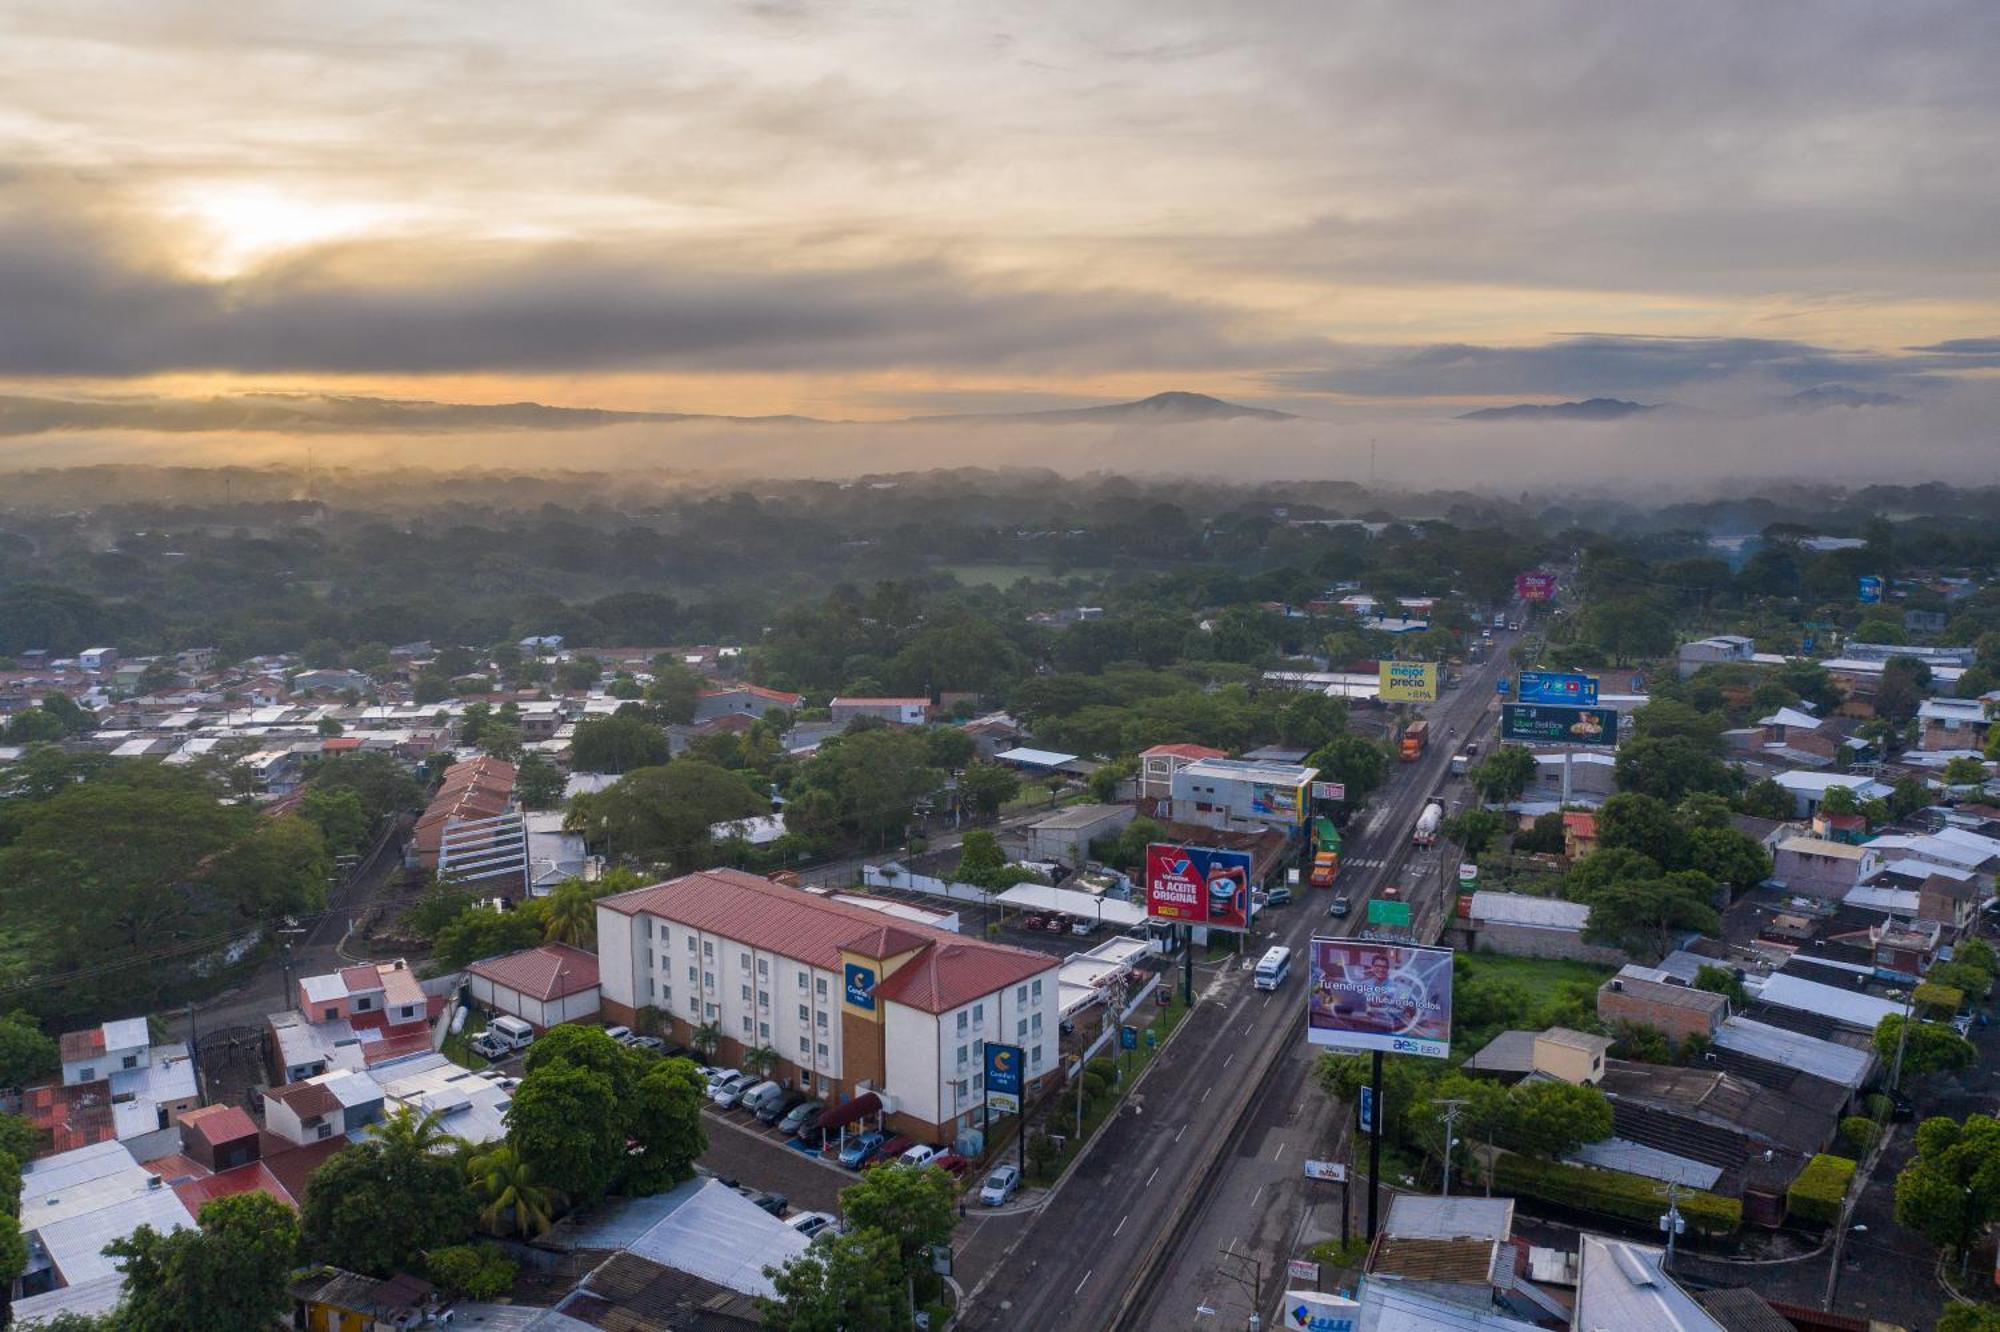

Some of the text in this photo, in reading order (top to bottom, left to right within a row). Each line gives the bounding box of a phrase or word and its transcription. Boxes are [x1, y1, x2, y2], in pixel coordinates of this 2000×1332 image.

[1392, 668, 1425, 678] mejor
[1390, 679, 1424, 688] precio
[1154, 880, 1197, 894] EL ACEITE
[1152, 890, 1198, 904] ORIGINAL
[1319, 979, 1331, 989] Tu
[1393, 1039, 1418, 1052] aes
